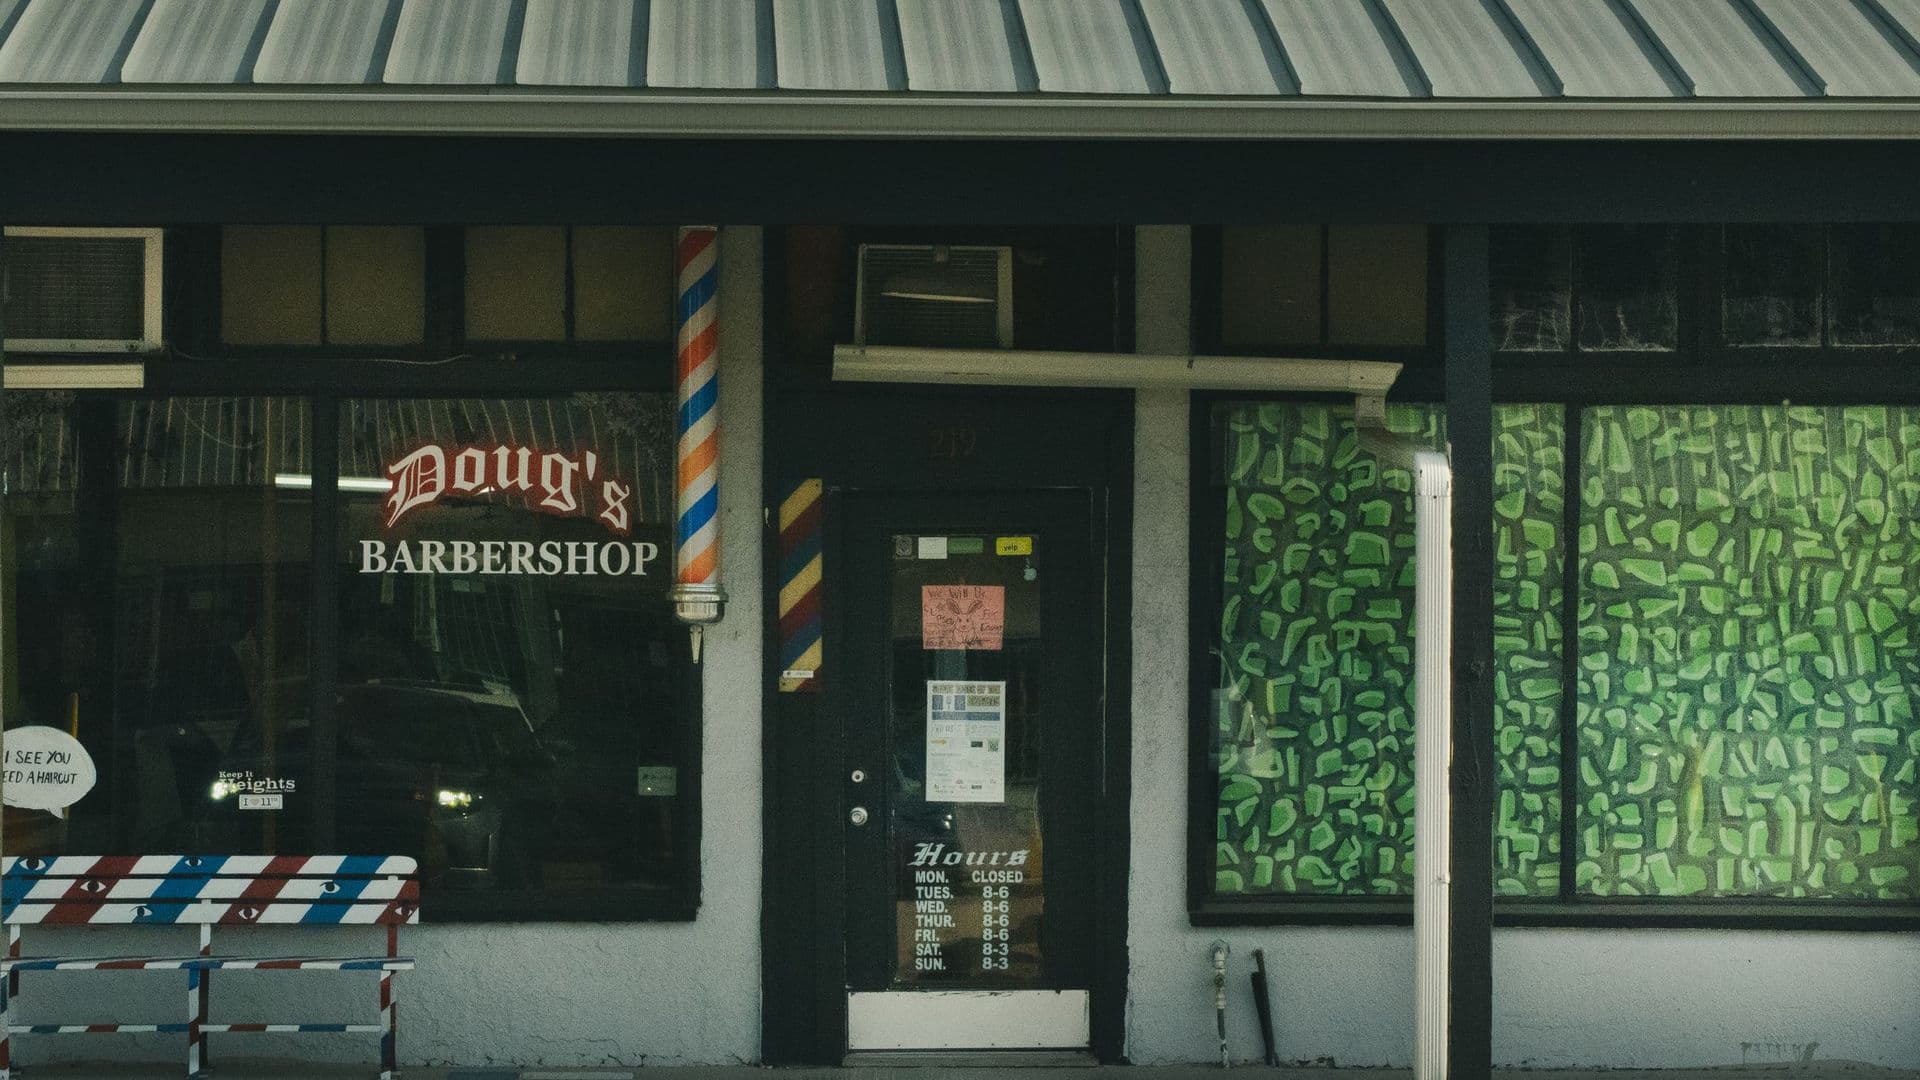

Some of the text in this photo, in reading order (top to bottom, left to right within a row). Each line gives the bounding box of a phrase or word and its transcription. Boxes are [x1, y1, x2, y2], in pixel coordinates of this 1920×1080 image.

[386, 444, 630, 530] Doug's
[1003, 542, 1019, 552] yelp
[358, 539, 659, 576] BARBERSHOP
[4, 749, 72, 765] I SEE YOU
[27, 771, 35, 785] A
[37, 771, 78, 785] HAIRCUT
[218, 770, 254, 780] Keep It
[906, 842, 1031, 867] Hours
[915, 871, 1024, 883] MON. CLOSED
[915, 886, 1009, 899] TUES. 8-6
[915, 900, 1009, 913] WED. 8-6
[915, 914, 1009, 928] THUR. 8-6
[915, 929, 1009, 942] FRI. 8-6
[915, 943, 1009, 956] SAT. 8-3
[915, 957, 1009, 970] SUN. 8-3
